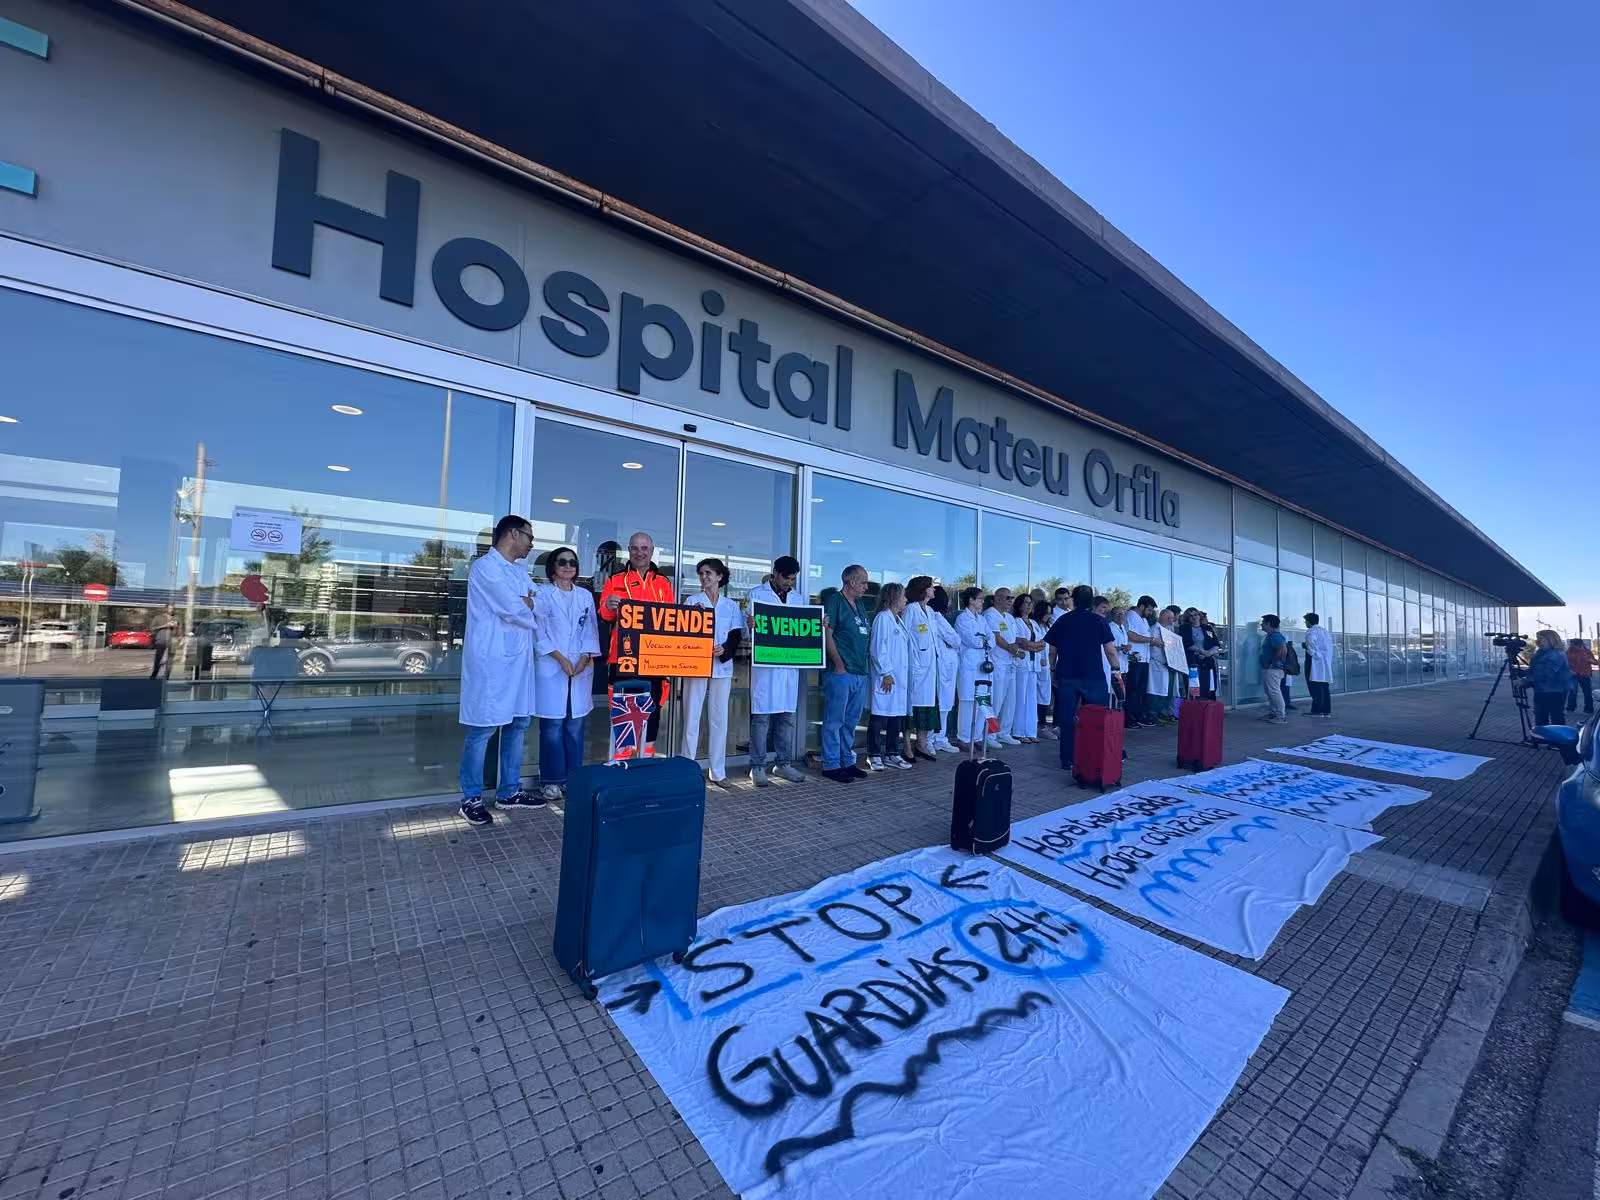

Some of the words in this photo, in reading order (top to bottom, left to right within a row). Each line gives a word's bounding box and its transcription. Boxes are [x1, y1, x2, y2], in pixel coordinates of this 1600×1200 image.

[271, 127, 852, 431] Hospital
[893, 368, 1070, 497] Mateu
[1084, 448, 1181, 529] Orfila
[620, 604, 645, 630] SE
[651, 607, 714, 635] VENDE
[755, 614, 769, 635] SE
[771, 616, 821, 637] VENDE
[682, 883, 923, 1003] STOP
